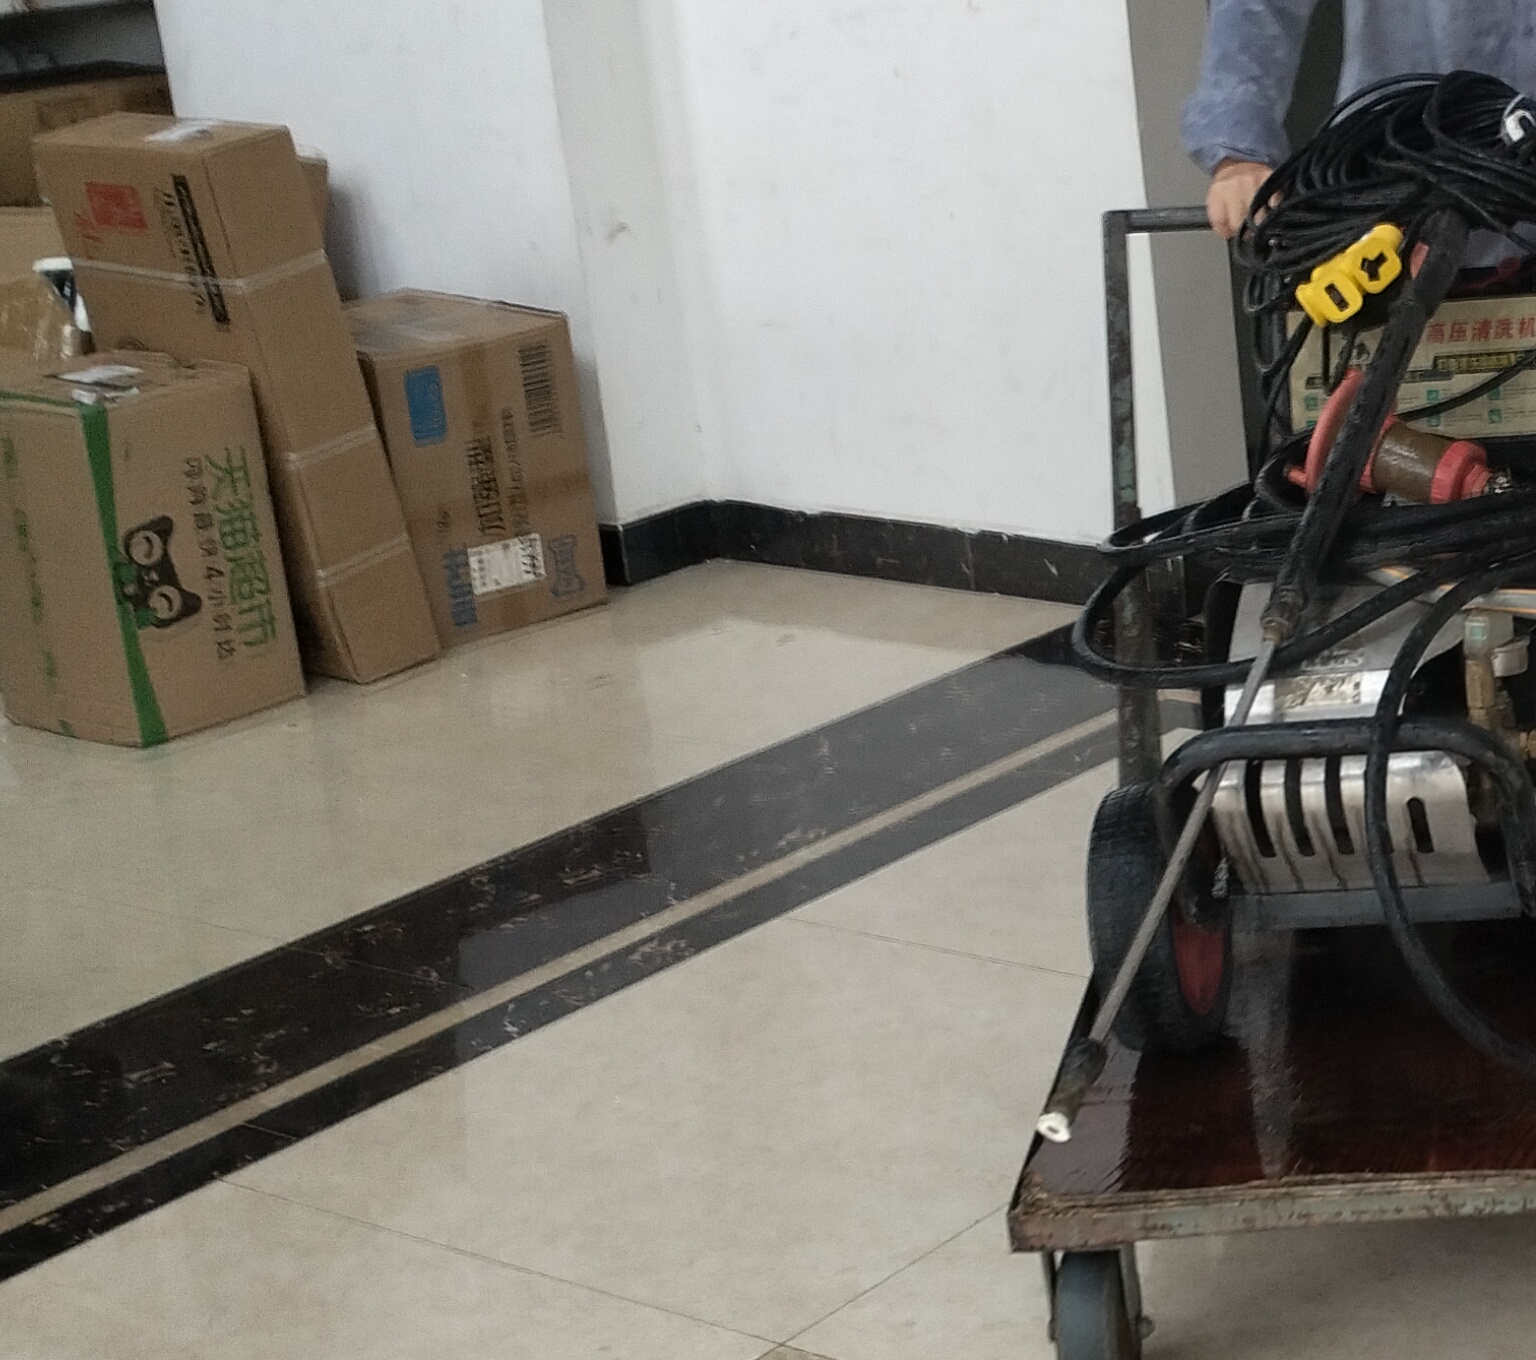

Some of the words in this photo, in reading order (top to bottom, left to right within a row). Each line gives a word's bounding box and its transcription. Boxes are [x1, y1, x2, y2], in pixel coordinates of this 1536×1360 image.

[1426, 317, 1536, 344] 高压清洗机
[204, 444, 276, 648] 天猫超市
